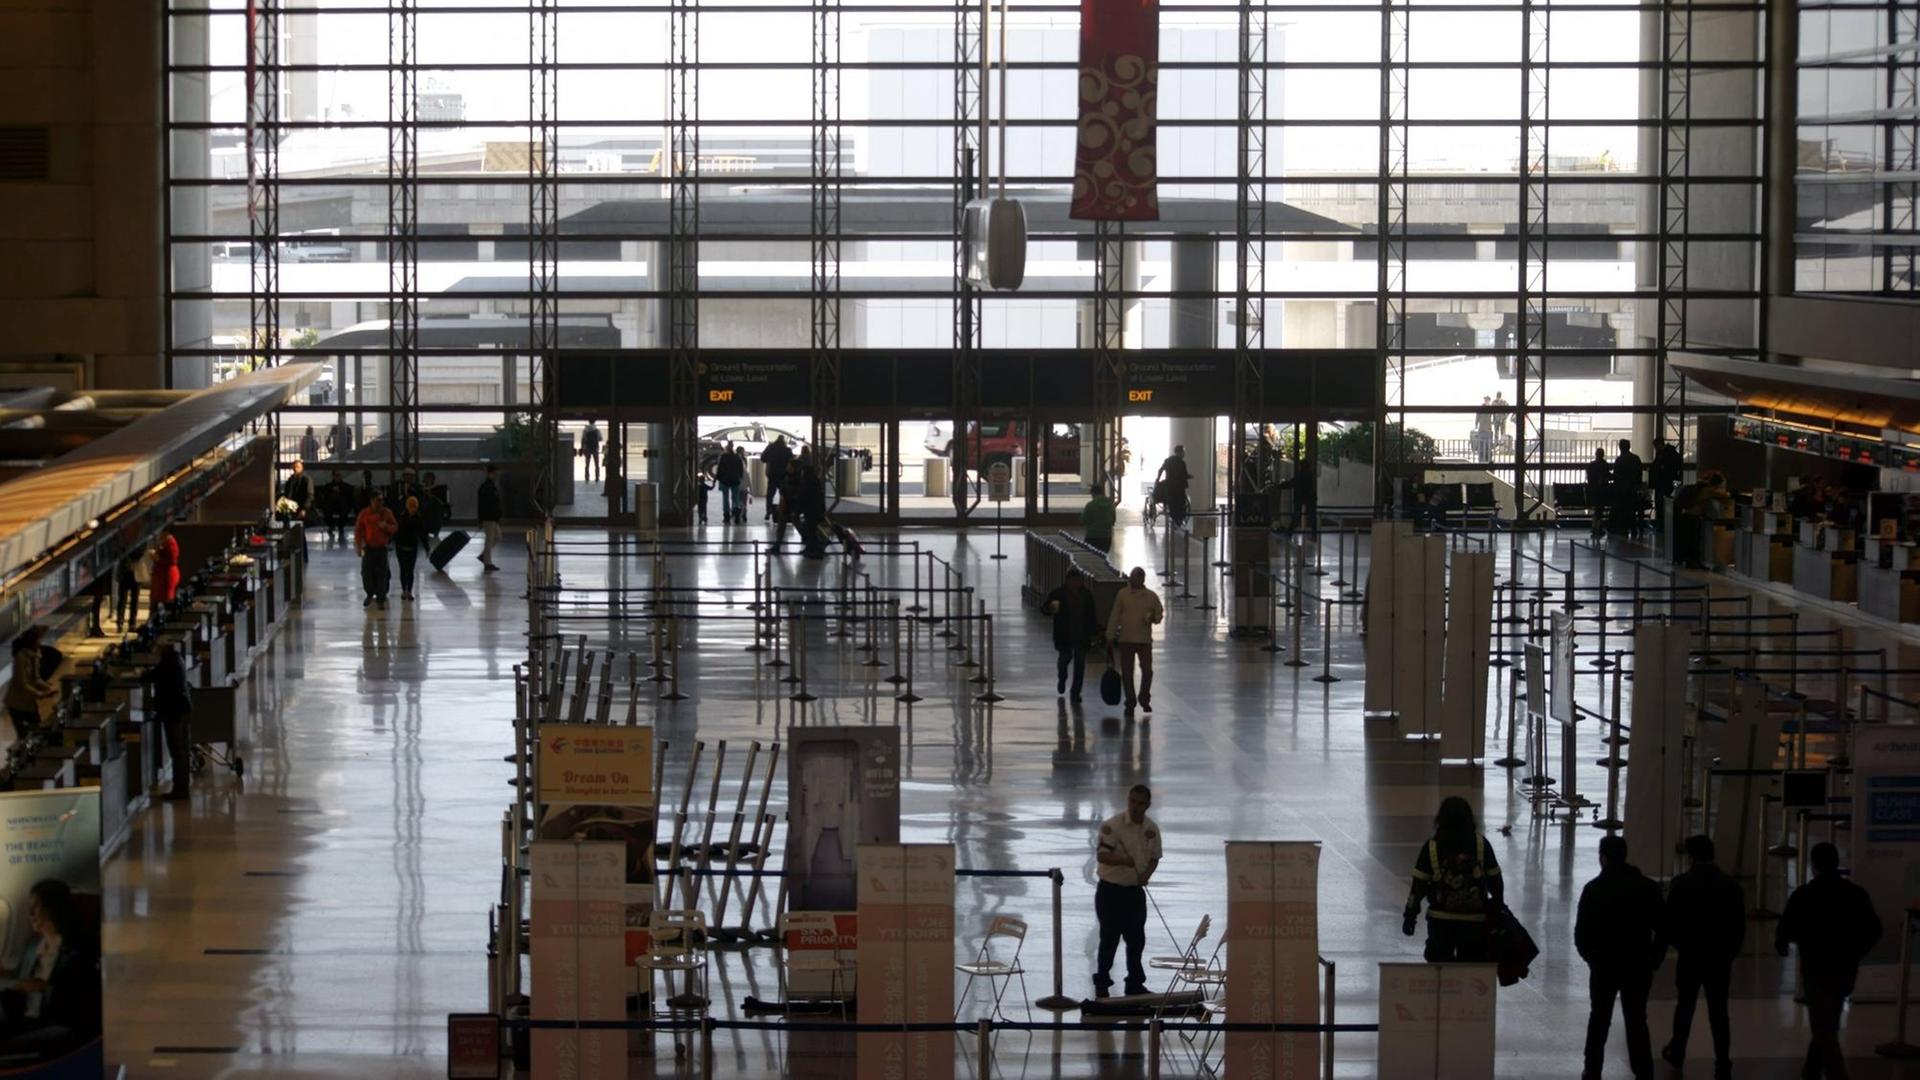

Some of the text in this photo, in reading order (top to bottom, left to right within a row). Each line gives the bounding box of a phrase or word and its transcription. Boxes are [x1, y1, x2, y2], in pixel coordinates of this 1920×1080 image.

[710, 362, 797, 374] Ground Transportation
[1162, 362, 1217, 374] Transportation
[746, 374, 768, 382] Level
[709, 389, 735, 402] EXIT
[1128, 389, 1153, 402] EXIT
[1240, 512, 1264, 523] LAN
[563, 769, 629, 784] Dream On
[565, 785, 601, 796] Shanghai
[5, 841, 24, 853] THE
[9, 855, 23, 865] OF
[800, 928, 824, 936] SKY
